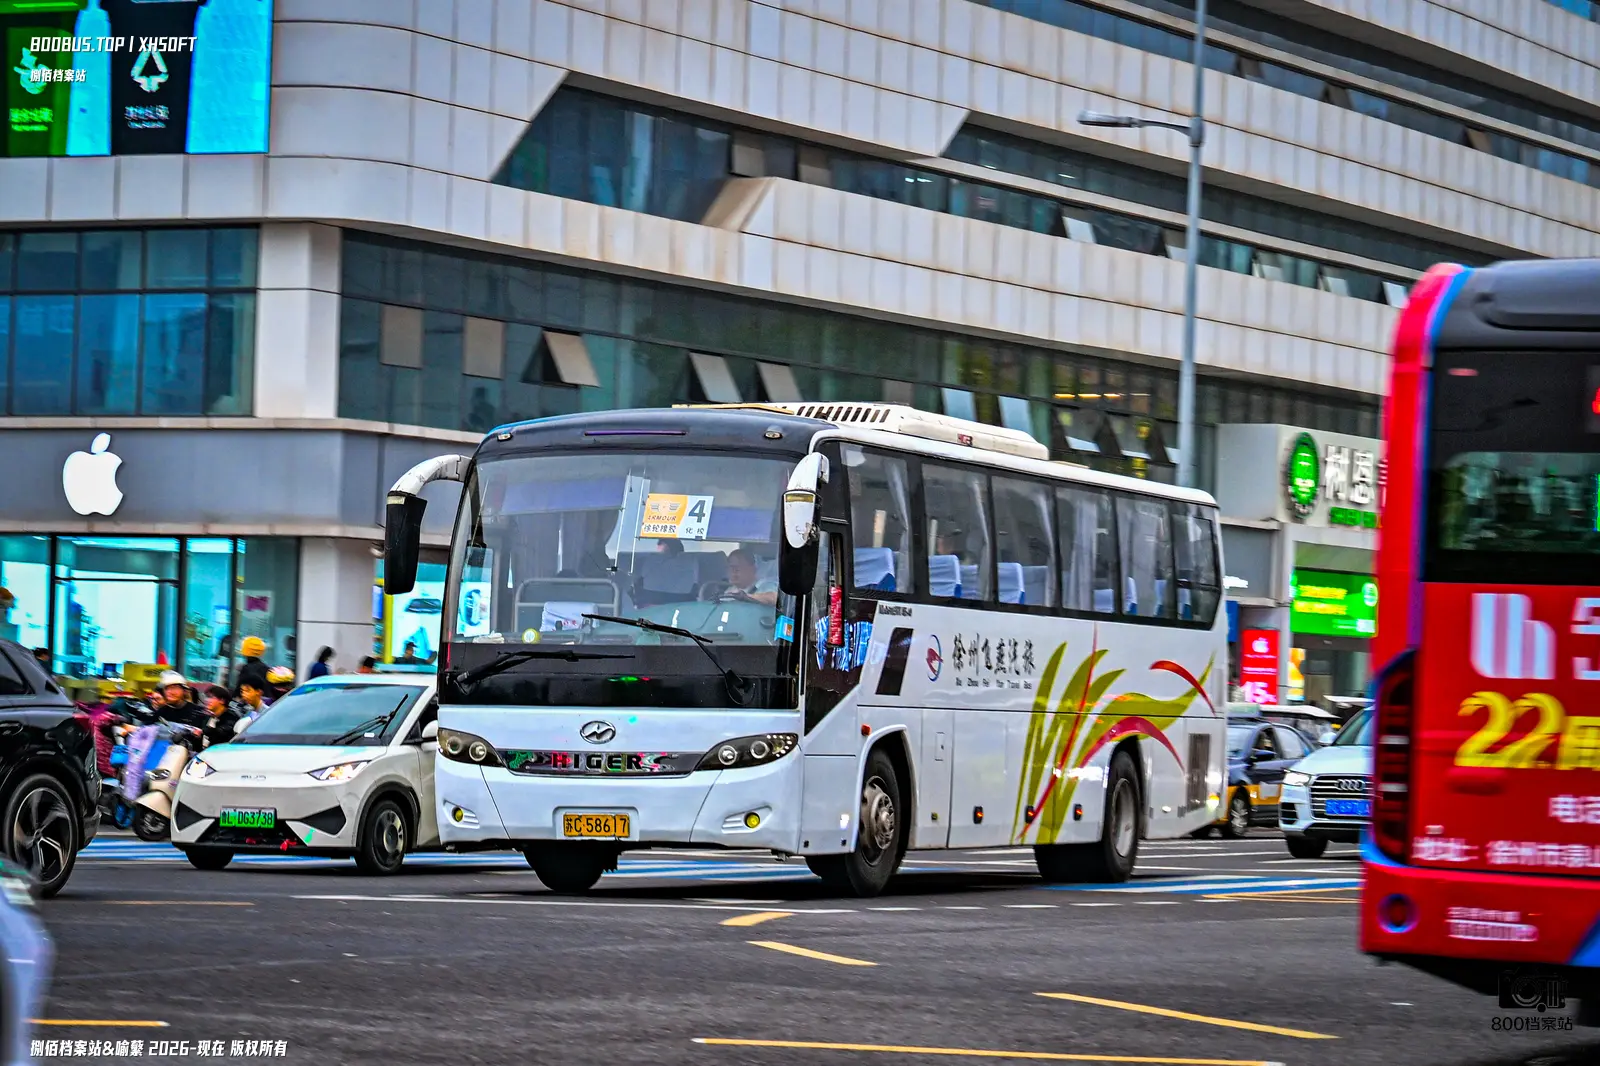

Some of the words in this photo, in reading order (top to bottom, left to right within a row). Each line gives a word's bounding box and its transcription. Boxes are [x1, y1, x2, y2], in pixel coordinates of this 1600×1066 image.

[688, 500, 706, 523] 4
[644, 523, 677, 534] 徐轮橡胶
[552, 752, 642, 771] HIGER
